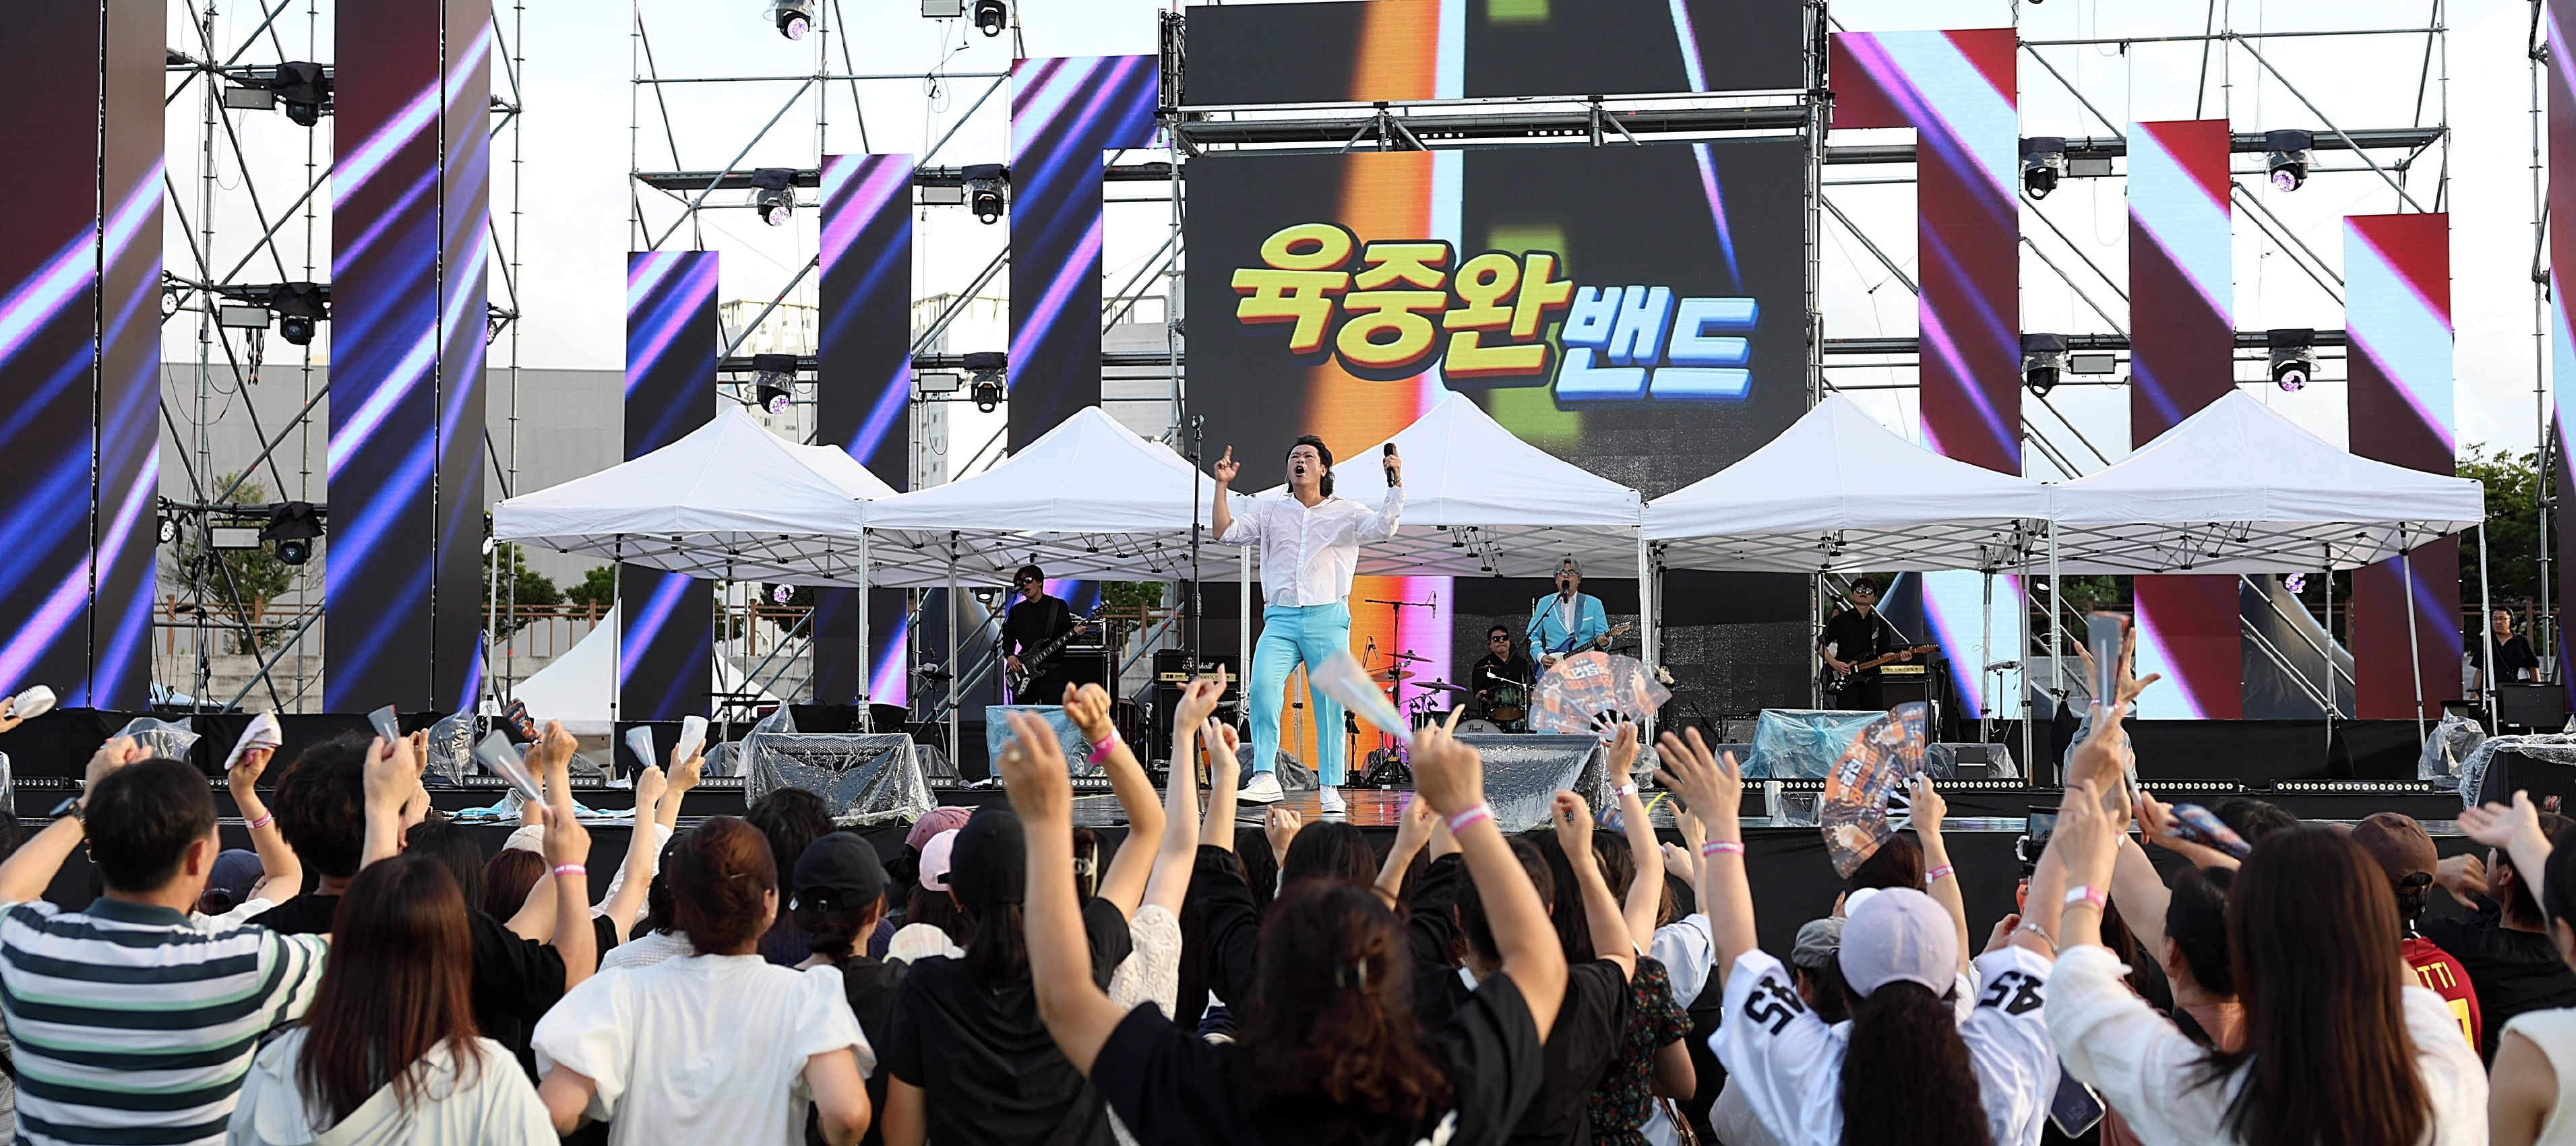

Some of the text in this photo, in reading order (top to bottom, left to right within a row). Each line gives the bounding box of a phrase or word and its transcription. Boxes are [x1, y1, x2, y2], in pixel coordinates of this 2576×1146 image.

[1465, 724, 1483, 732] Pearl
[1979, 971, 2043, 1015] 45
[2412, 961, 2457, 991] TTI
[1744, 976, 1804, 1036] 45
